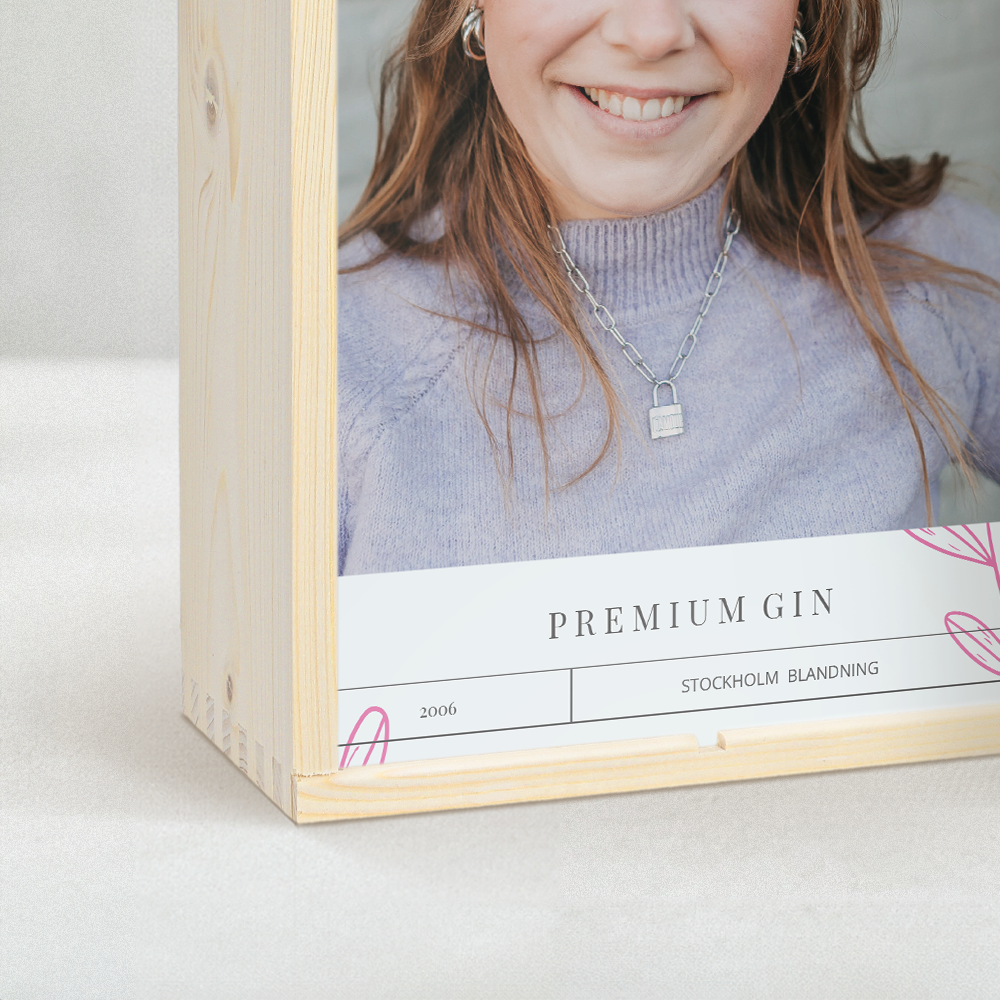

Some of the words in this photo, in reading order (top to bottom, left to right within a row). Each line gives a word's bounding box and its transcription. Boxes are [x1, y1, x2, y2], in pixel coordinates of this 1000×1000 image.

[548, 593, 746, 640] PREMIUM
[763, 587, 833, 620] GIN
[681, 670, 779, 694] STOCKHOLM
[788, 660, 880, 684] BLANDNING
[419, 701, 458, 719] 2006
